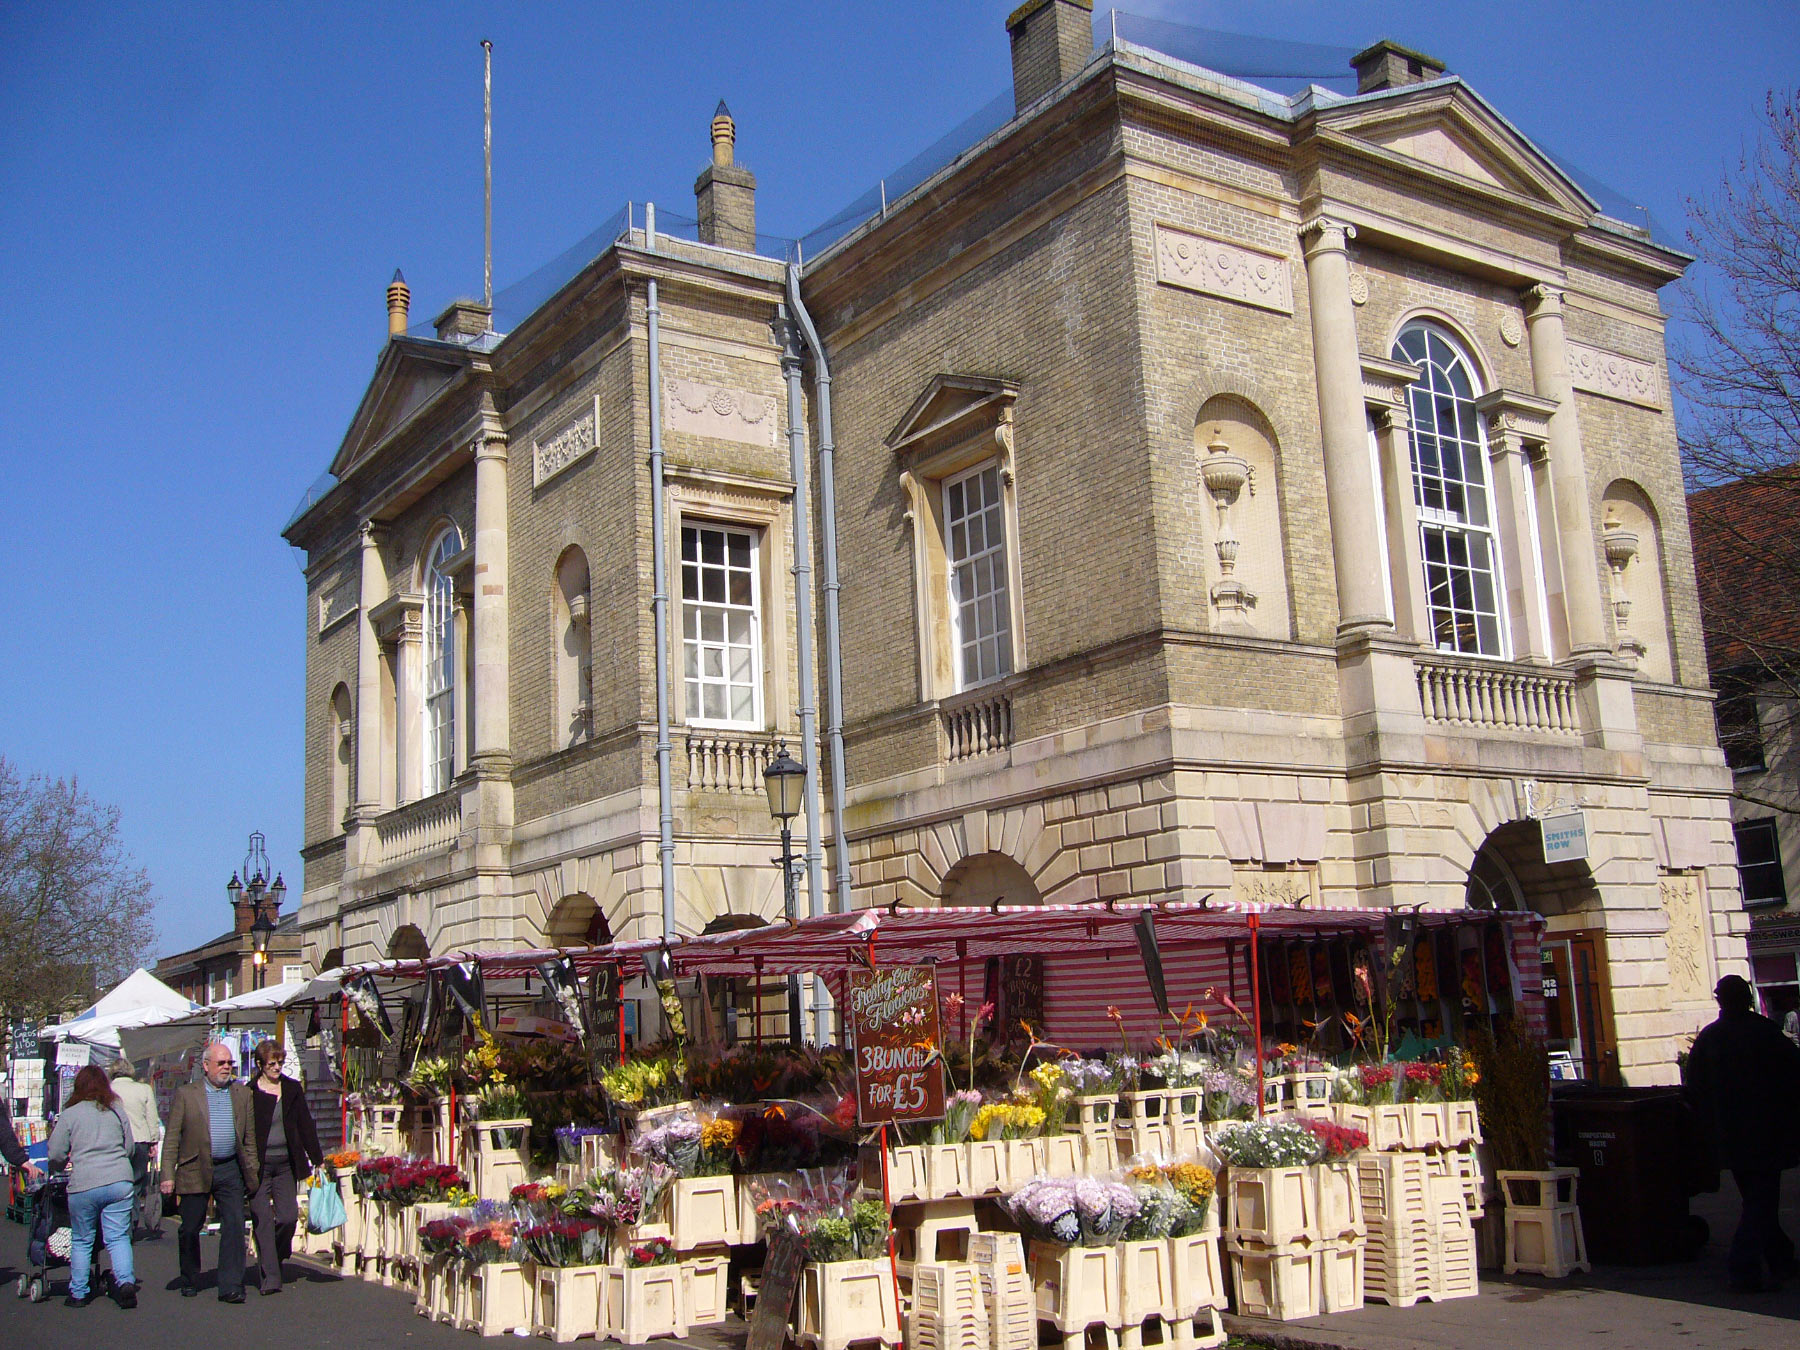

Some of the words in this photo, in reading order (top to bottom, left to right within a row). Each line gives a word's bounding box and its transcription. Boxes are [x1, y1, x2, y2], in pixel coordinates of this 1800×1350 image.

[1545, 829, 1584, 841] SMITHS
[1546, 840, 1570, 850] ROW
[595, 969, 608, 1002] £2
[866, 984, 924, 1028] Flowers
[868, 1082, 892, 1105] FOR
[892, 1072, 927, 1112] £5
